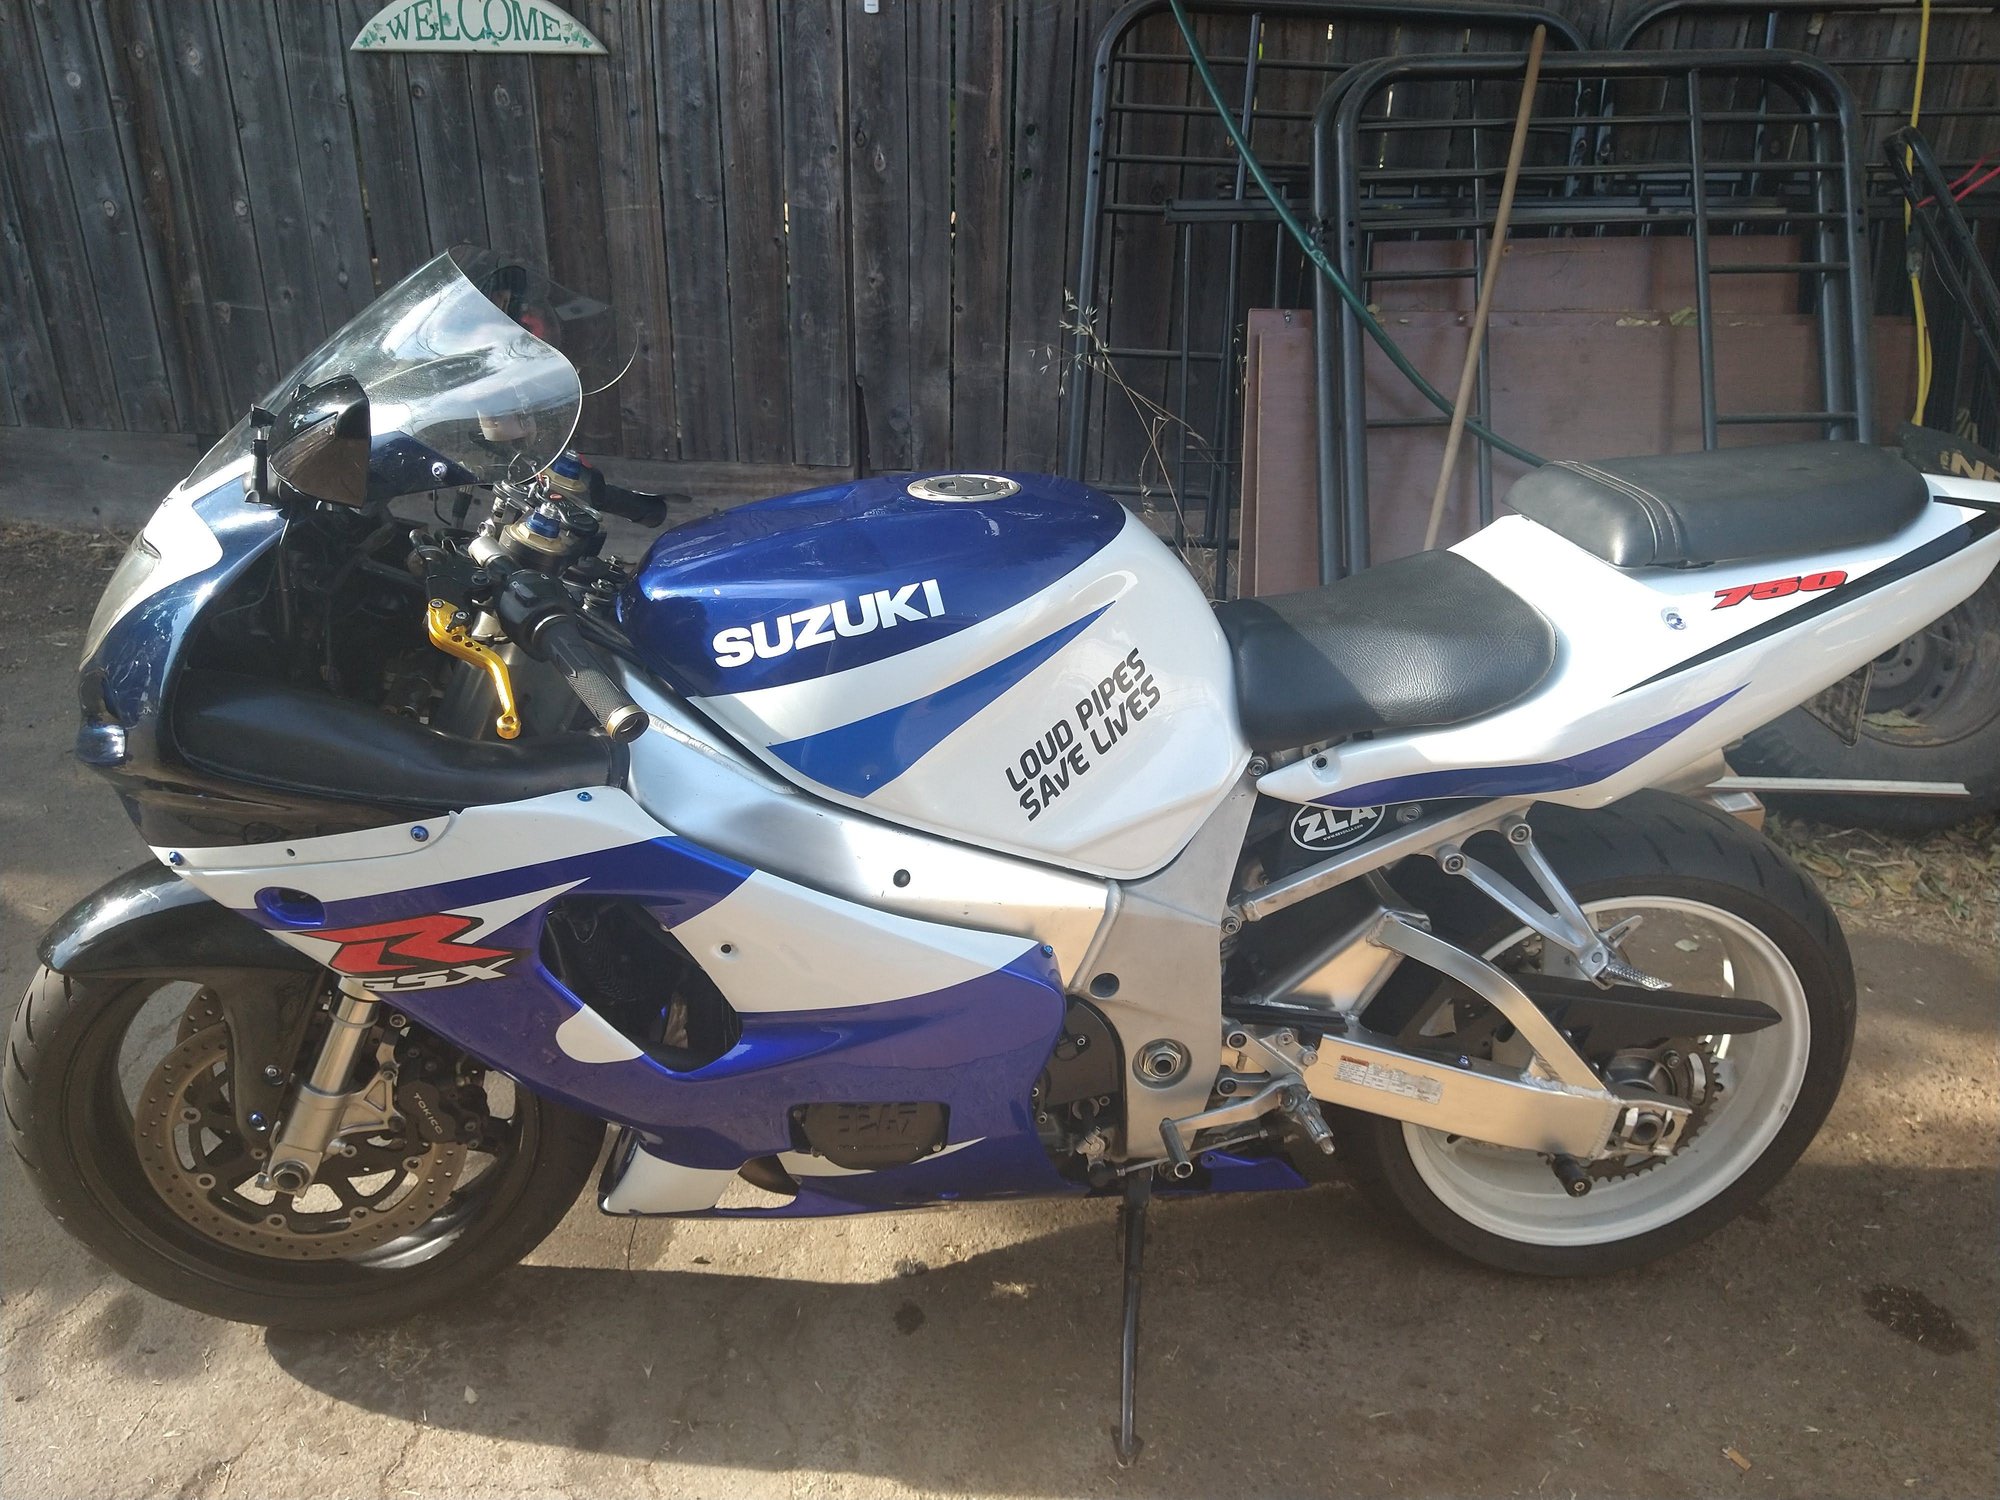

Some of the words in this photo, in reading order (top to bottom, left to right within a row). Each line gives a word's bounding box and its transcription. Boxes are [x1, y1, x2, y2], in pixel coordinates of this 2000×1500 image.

[386, 0, 562, 42] WELCOME
[1711, 570, 1848, 611] 750
[712, 578, 946, 668] SUZUKI
[1005, 719, 1074, 792] LOUD
[1075, 647, 1146, 731] PIPES
[1019, 742, 1091, 822] SAVE
[1089, 674, 1161, 755] LIVES
[1298, 807, 1378, 842] ZLA
[302, 912, 514, 974] R
[350, 957, 516, 993] GSX
[413, 1092, 443, 1135] TOKICO
